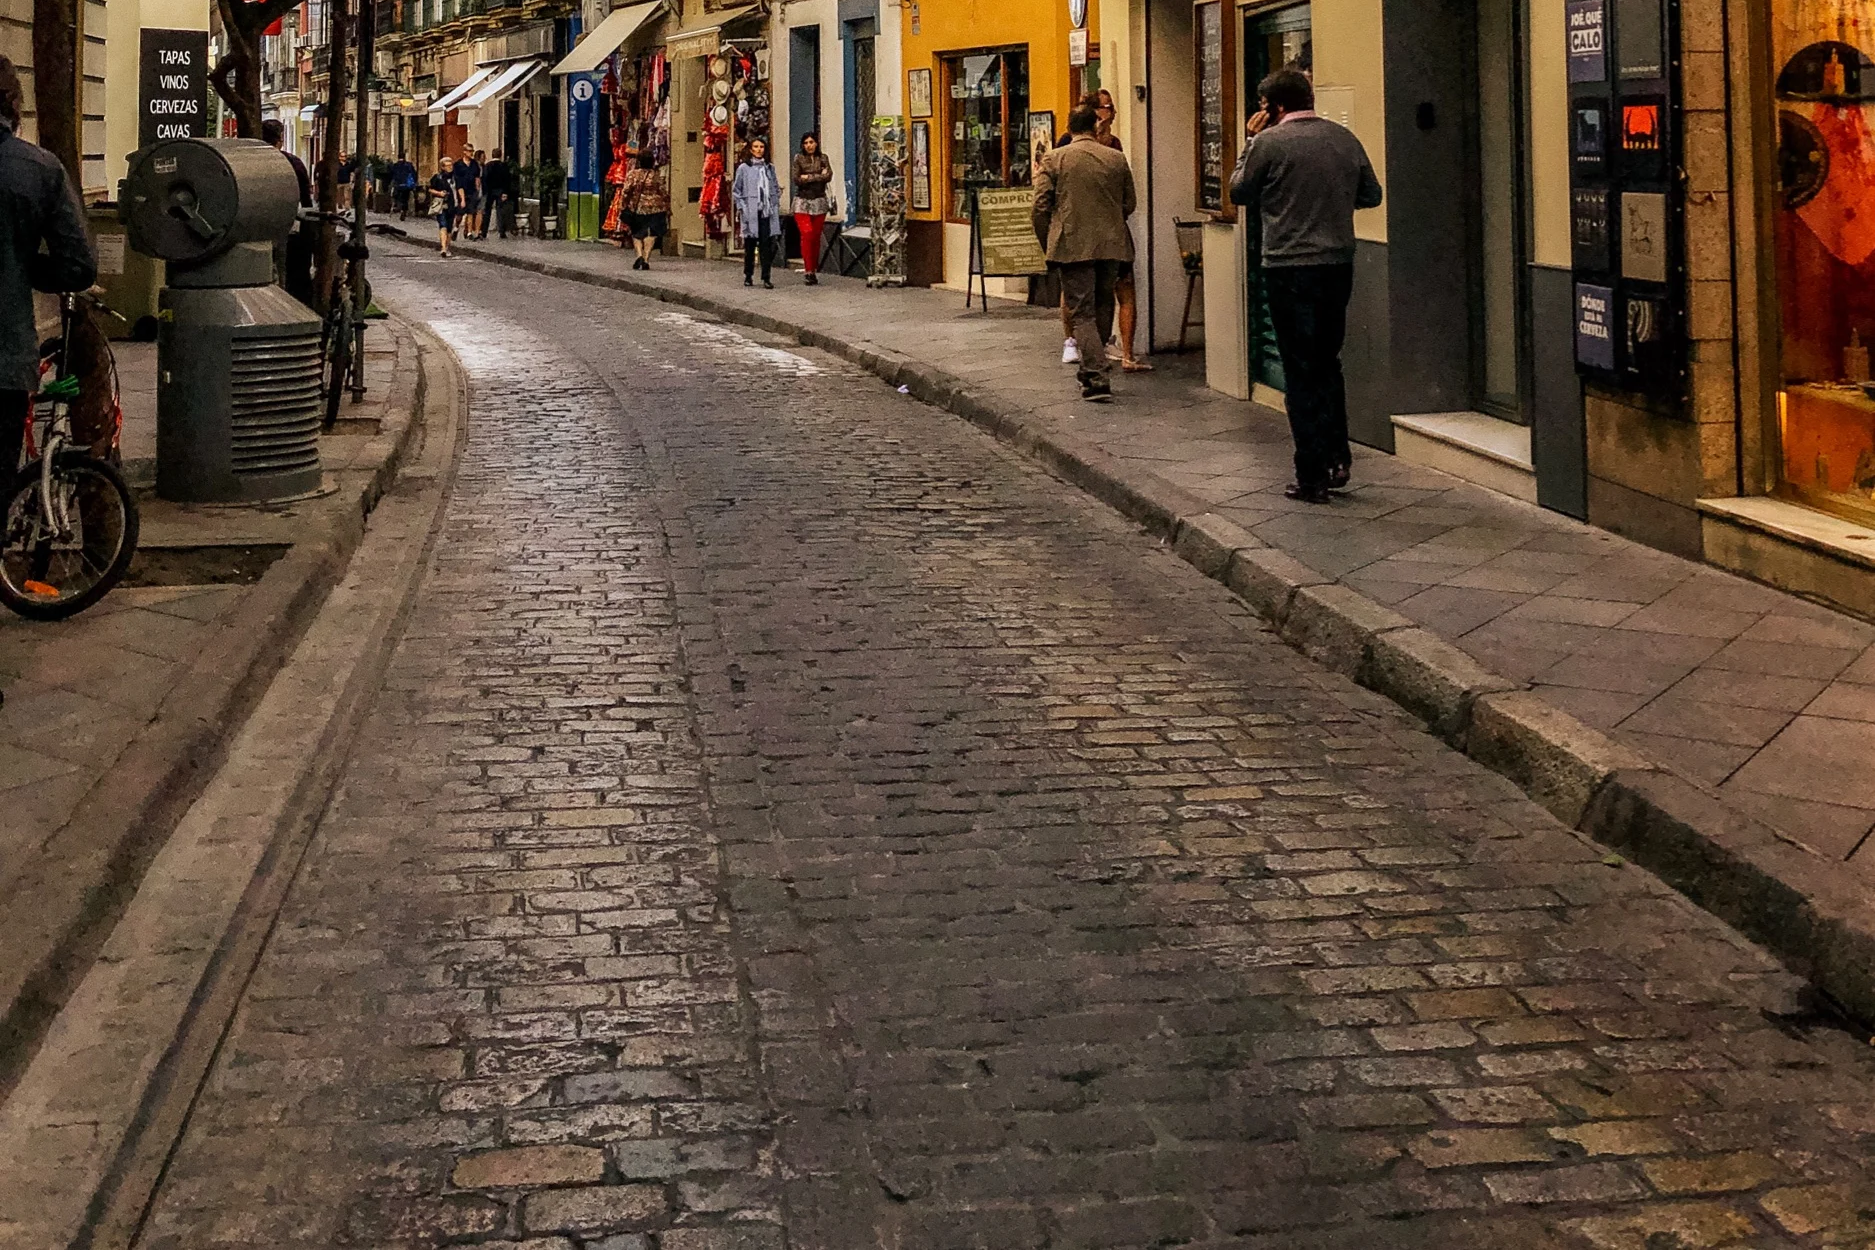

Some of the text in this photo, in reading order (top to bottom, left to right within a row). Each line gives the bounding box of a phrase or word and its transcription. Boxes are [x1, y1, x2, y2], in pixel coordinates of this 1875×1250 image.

[158, 50, 191, 65] TAPAS
[159, 74, 189, 90] VINOS
[149, 99, 198, 114] CERVEZAS
[156, 124, 190, 139] CAVAS
